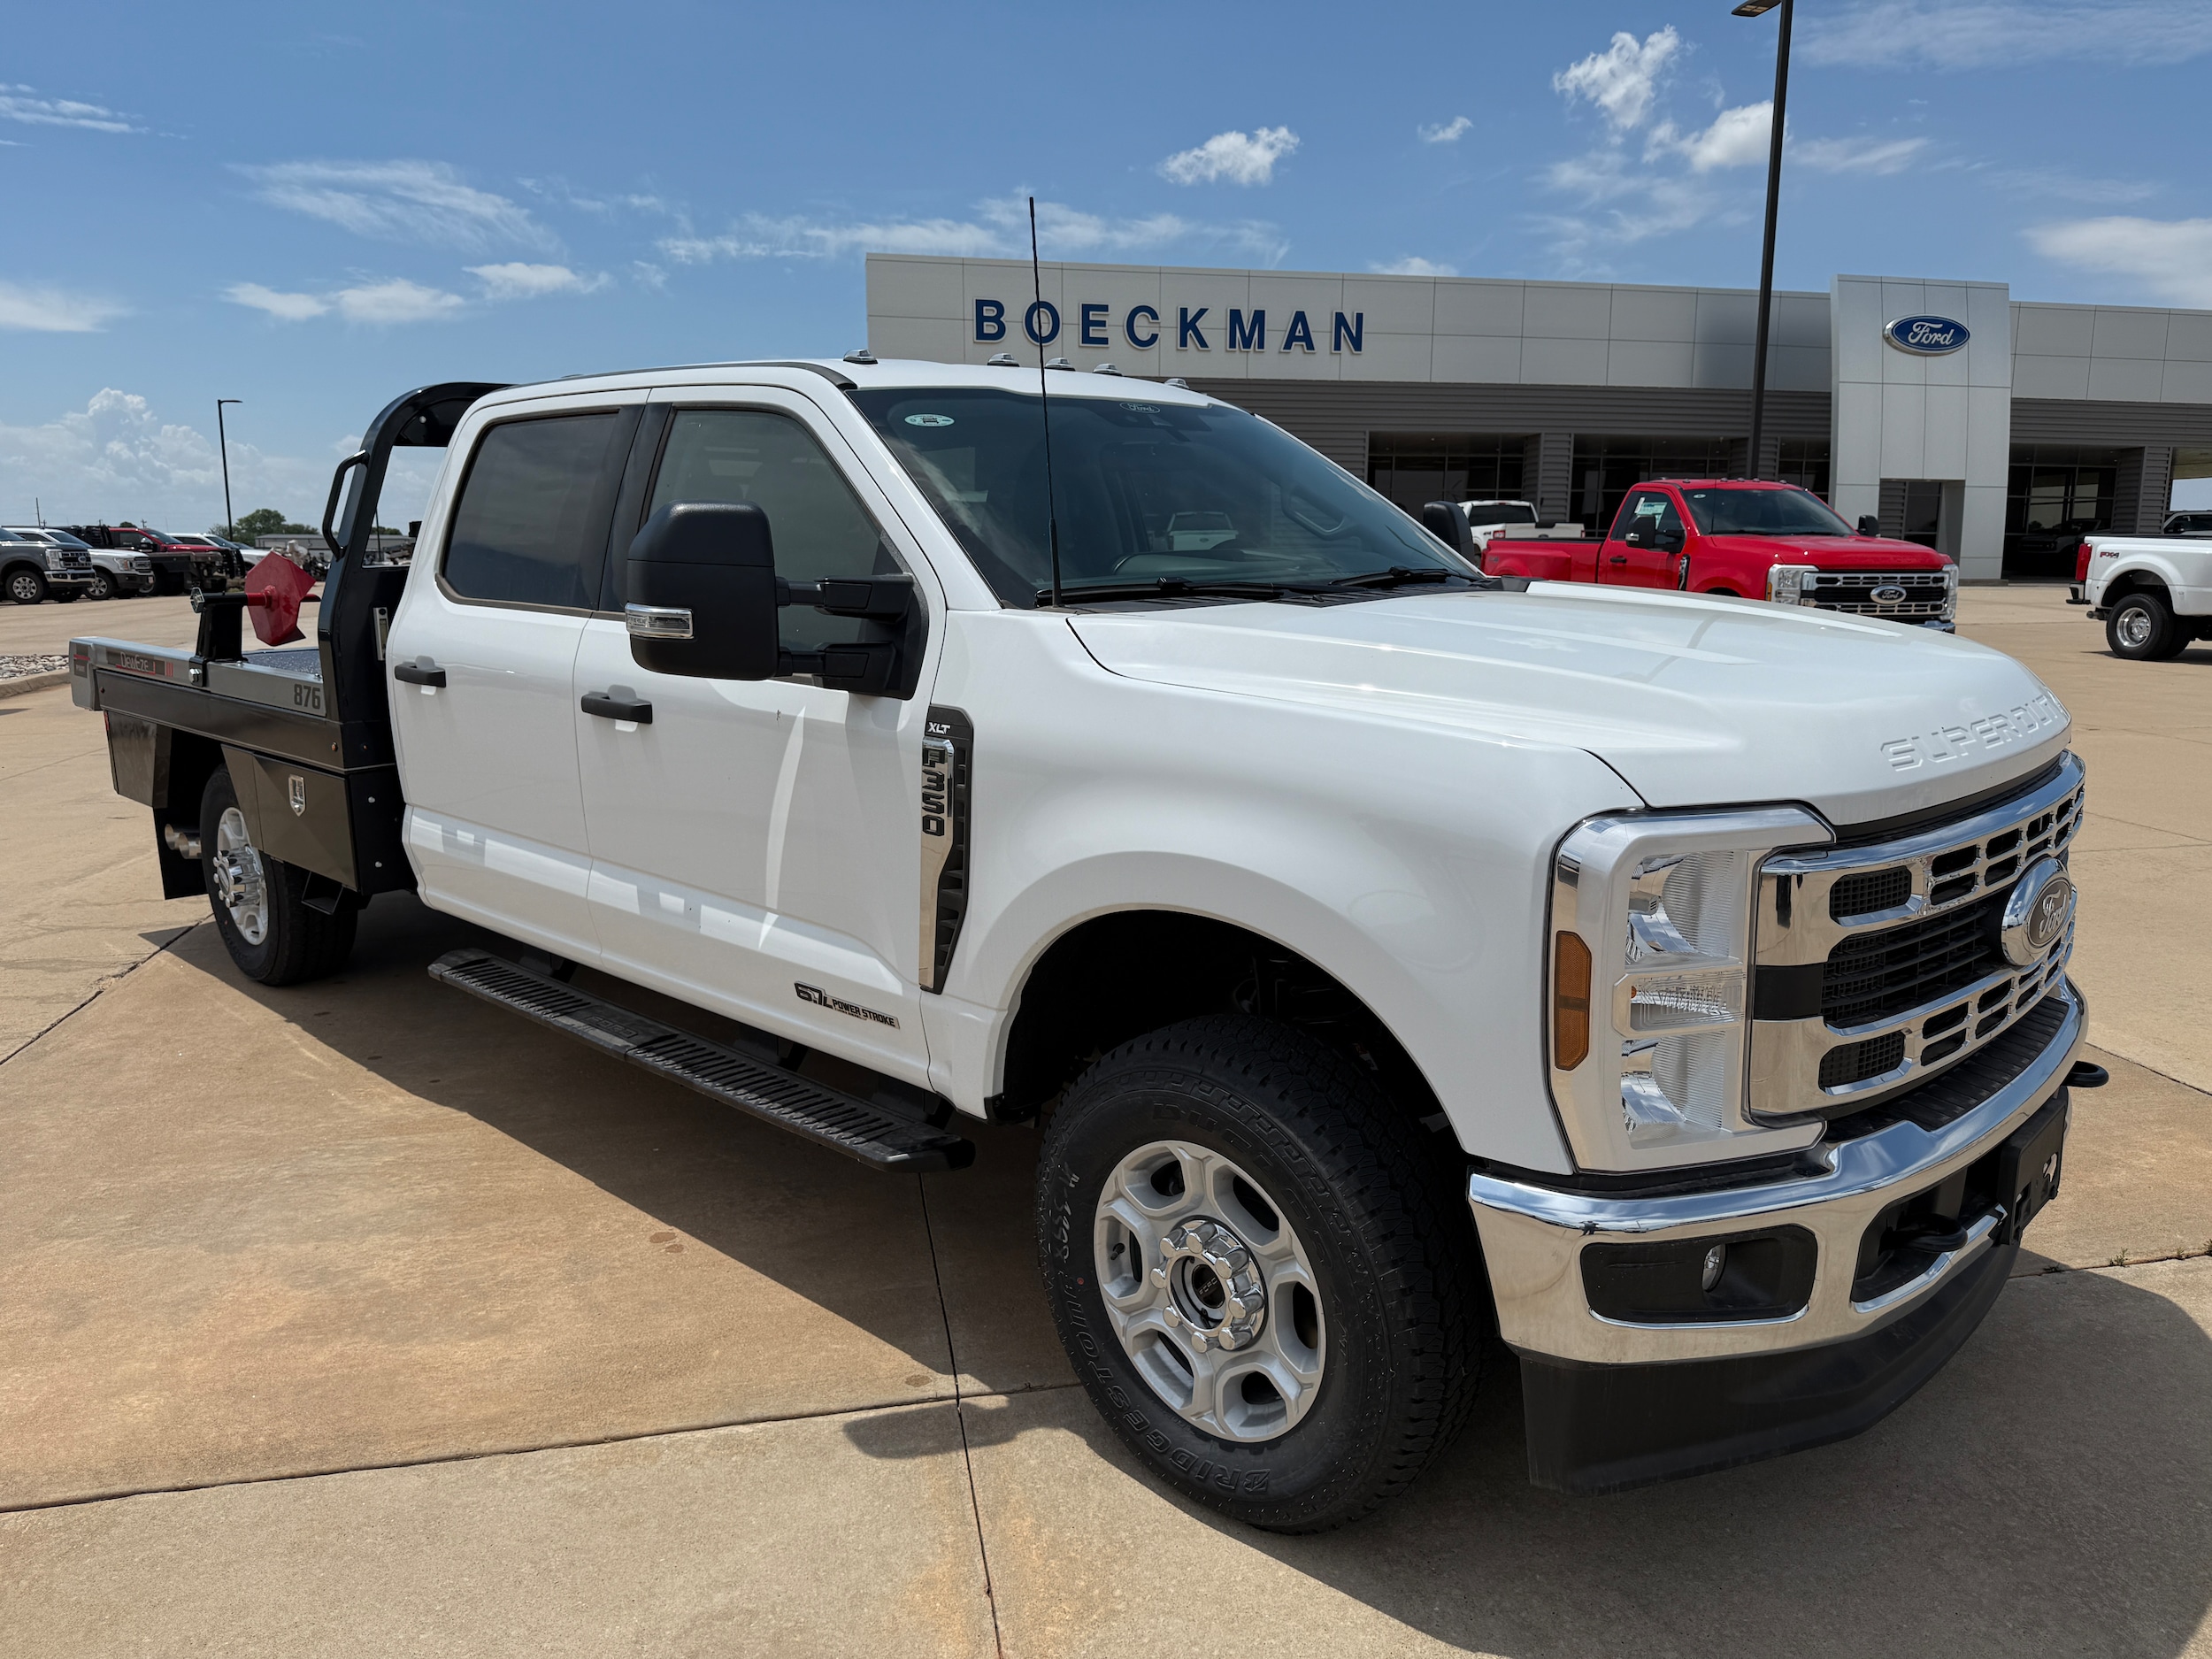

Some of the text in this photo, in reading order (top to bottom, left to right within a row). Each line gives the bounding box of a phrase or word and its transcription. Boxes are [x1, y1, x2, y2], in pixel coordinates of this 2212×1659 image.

[974, 298, 1363, 353] BOECKMAN
[1908, 321, 1955, 345] Ford
[1881, 589, 1900, 600] Ford
[294, 683, 321, 710] 876
[927, 722, 951, 734] XLT
[1880, 713, 2023, 772] SUPER
[922, 748, 946, 837] F350
[2039, 889, 2067, 940] Ford
[832, 998, 861, 1017] POWER
[862, 1009, 896, 1027] STROKE
